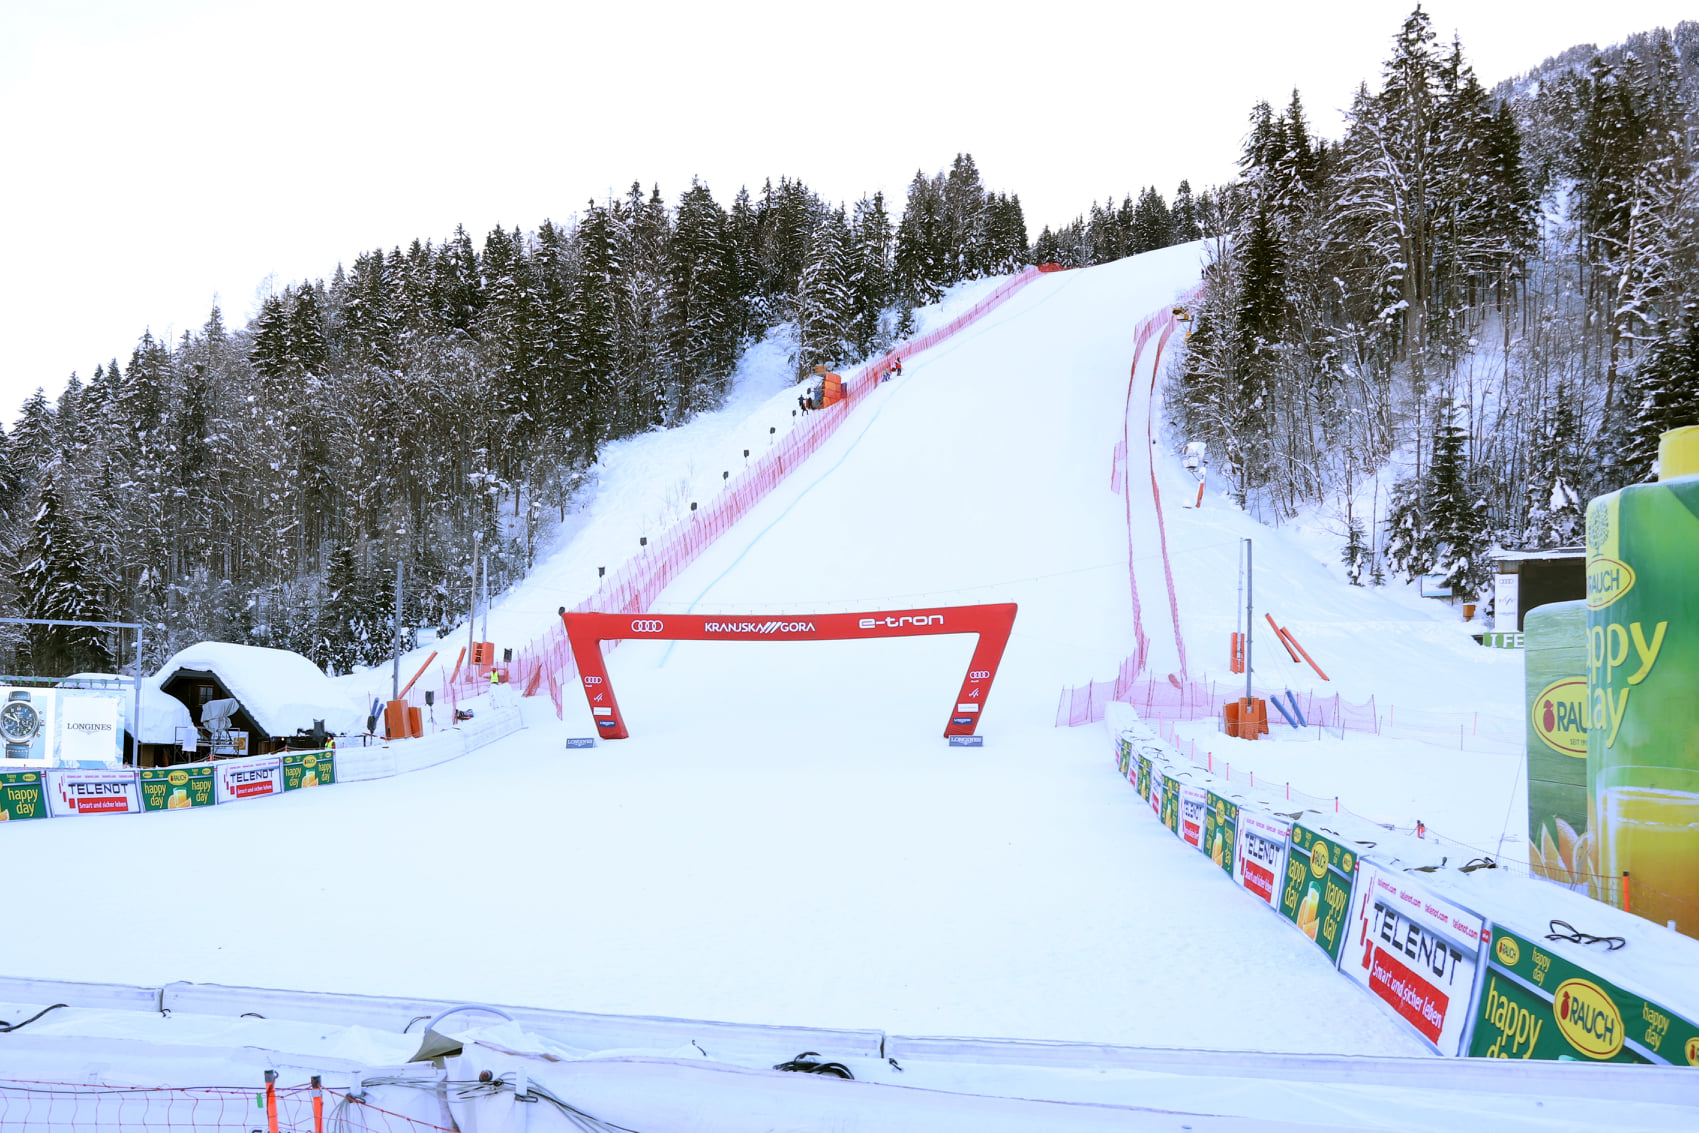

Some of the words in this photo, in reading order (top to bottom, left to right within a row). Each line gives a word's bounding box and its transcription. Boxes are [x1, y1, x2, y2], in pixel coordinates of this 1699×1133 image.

[704, 622, 765, 633] KRANJSKA
[780, 622, 816, 632] GORA
[858, 615, 944, 629] e-tron
[67, 722, 112, 731] LONGINES
[191, 780, 212, 792] happy
[230, 768, 275, 783] TELENOT
[7, 787, 39, 802] happy
[68, 783, 128, 795] TELENOT
[144, 782, 167, 796] happy
[196, 791, 208, 804] day
[16, 801, 35, 817] day
[150, 794, 164, 809] day
[1245, 833, 1280, 867] TELENOT
[1284, 881, 1300, 917] day
[1324, 872, 1347, 922] happy
[1323, 909, 1338, 951] day
[1374, 902, 1463, 986] TELENOT
[1531, 946, 1552, 973] happy
[1532, 964, 1546, 987] day
[1372, 960, 1393, 987] Smart
[1390, 977, 1406, 997] und
[1402, 984, 1424, 1012] sicher
[1422, 996, 1443, 1029] leben
[1485, 976, 1543, 1059] happy
[1569, 996, 1615, 1047] RAUCH
[1642, 1001, 1671, 1036] happy
[1644, 1024, 1663, 1052] day
